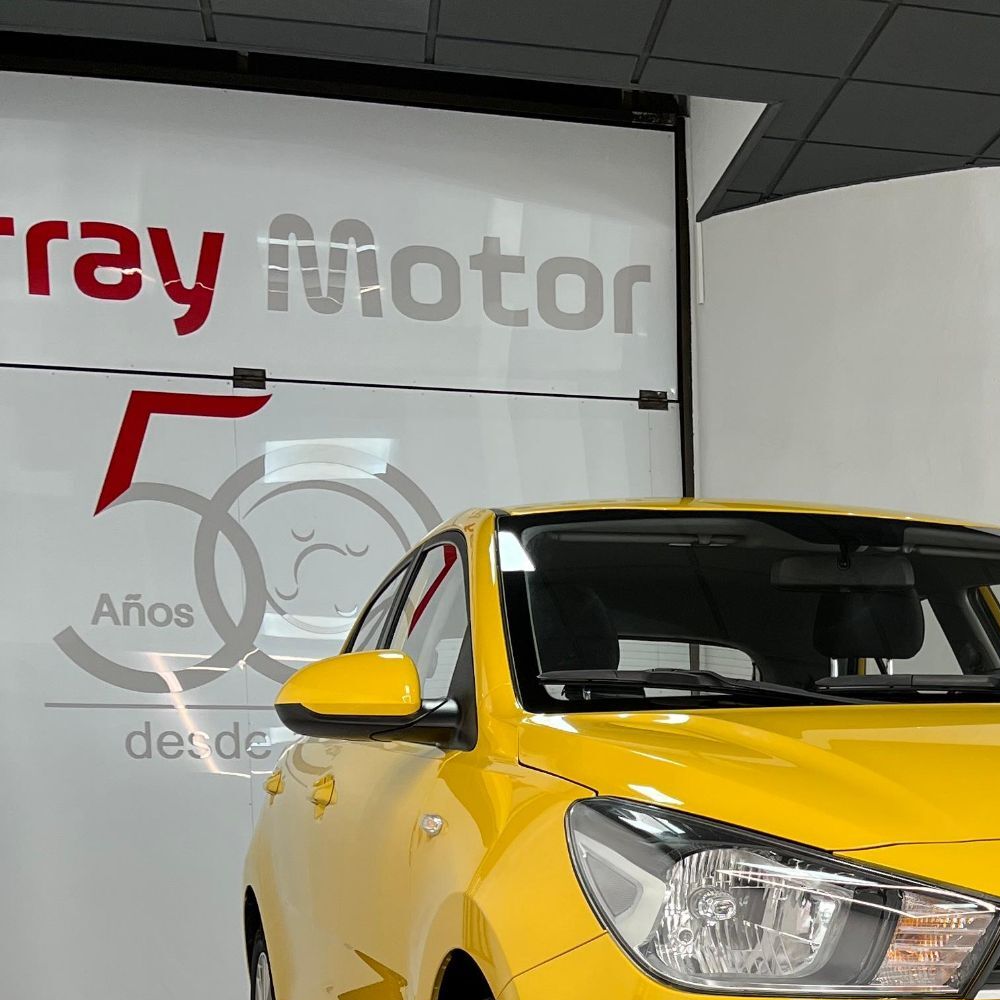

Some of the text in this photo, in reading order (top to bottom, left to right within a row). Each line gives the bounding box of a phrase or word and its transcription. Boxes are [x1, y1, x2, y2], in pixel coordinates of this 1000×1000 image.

[266, 212, 652, 334] Motor
[90, 592, 195, 629] Años
[125, 721, 272, 760] desde
